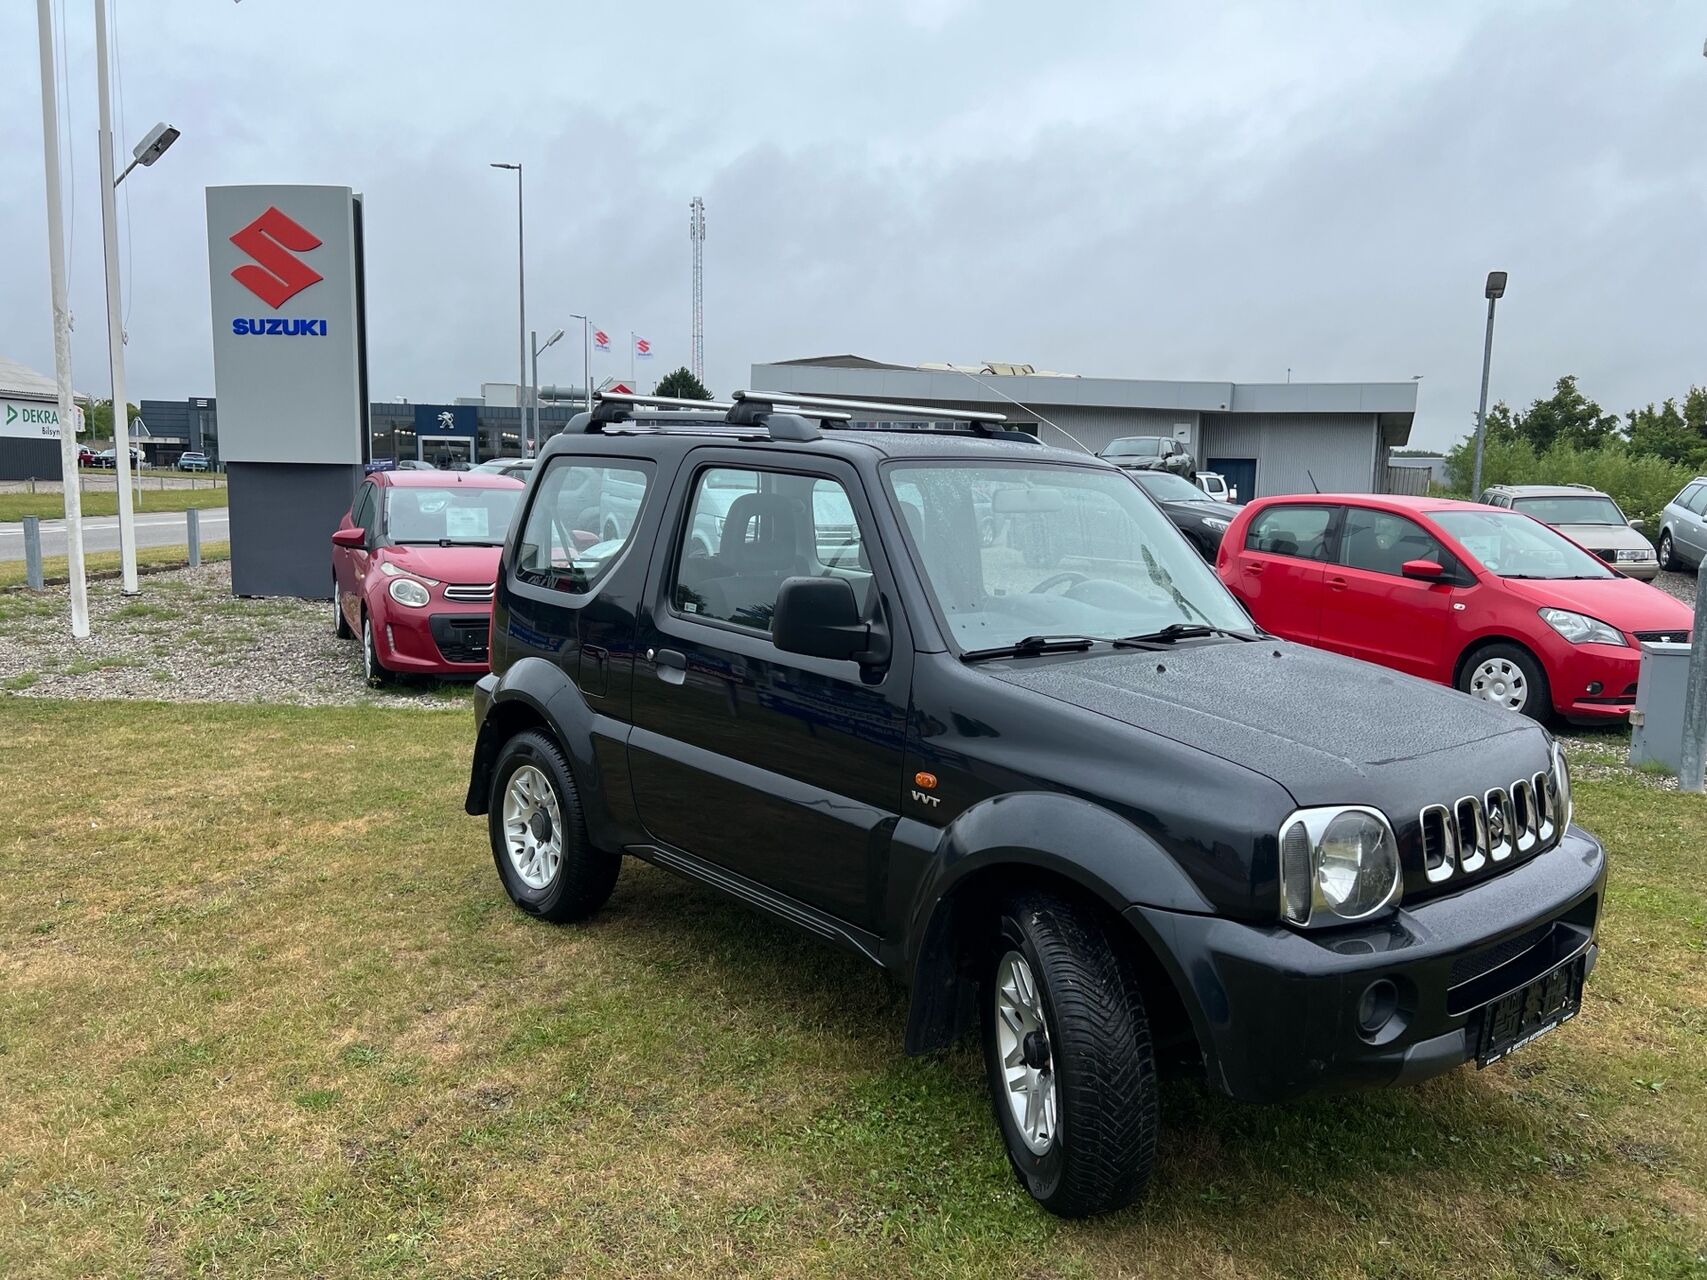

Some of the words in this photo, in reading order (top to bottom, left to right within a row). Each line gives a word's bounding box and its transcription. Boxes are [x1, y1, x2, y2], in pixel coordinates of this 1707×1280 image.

[232, 318, 327, 336] SUZUKI
[22, 408, 60, 424] DEKRA
[911, 790, 941, 807] VVT
